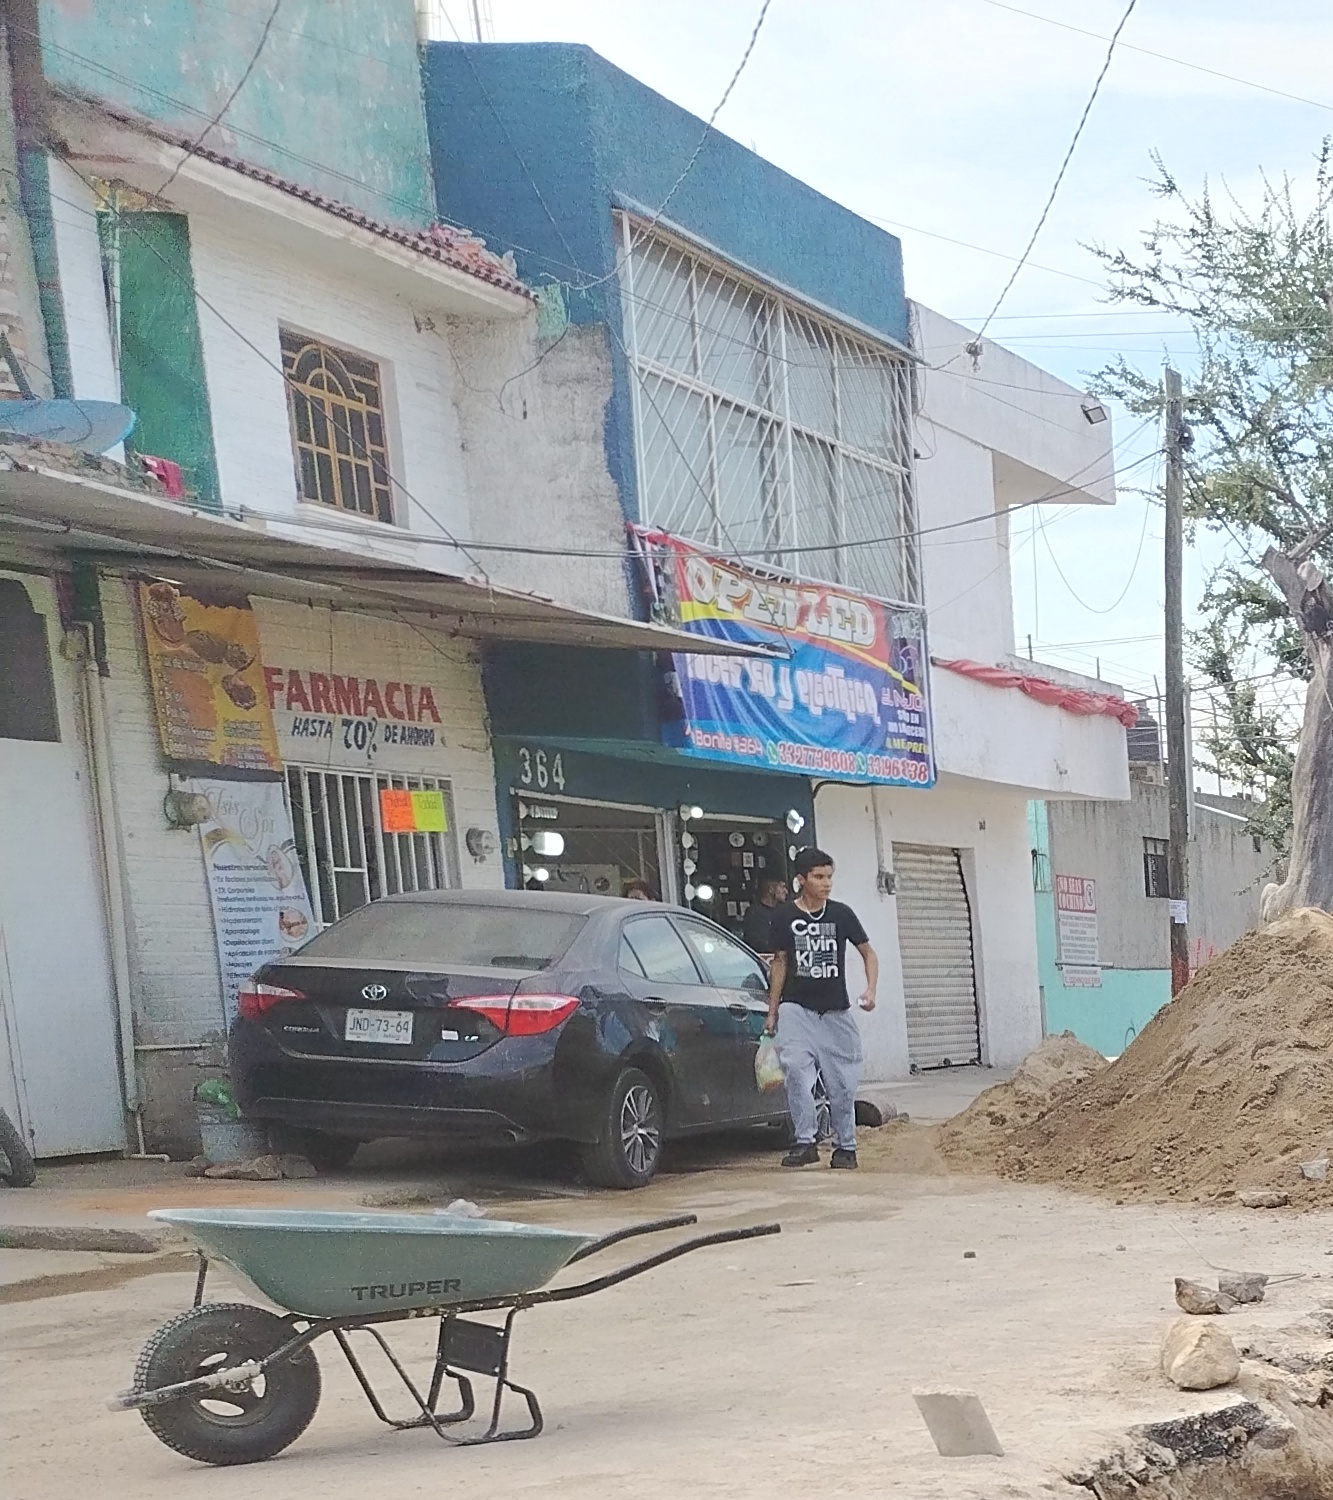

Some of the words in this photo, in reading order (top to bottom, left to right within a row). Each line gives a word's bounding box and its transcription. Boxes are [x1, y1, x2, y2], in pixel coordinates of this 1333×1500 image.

[686, 556, 799, 632] OPEN
[804, 589, 877, 648] LED
[263, 666, 442, 723] FARMACIA
[291, 716, 333, 738] HASTA
[341, 717, 377, 760] 70%
[384, 725, 398, 744] DE
[400, 725, 435, 747] AHORRO
[519, 747, 566, 791] 364
[351, 1279, 461, 1301] TRUPER
